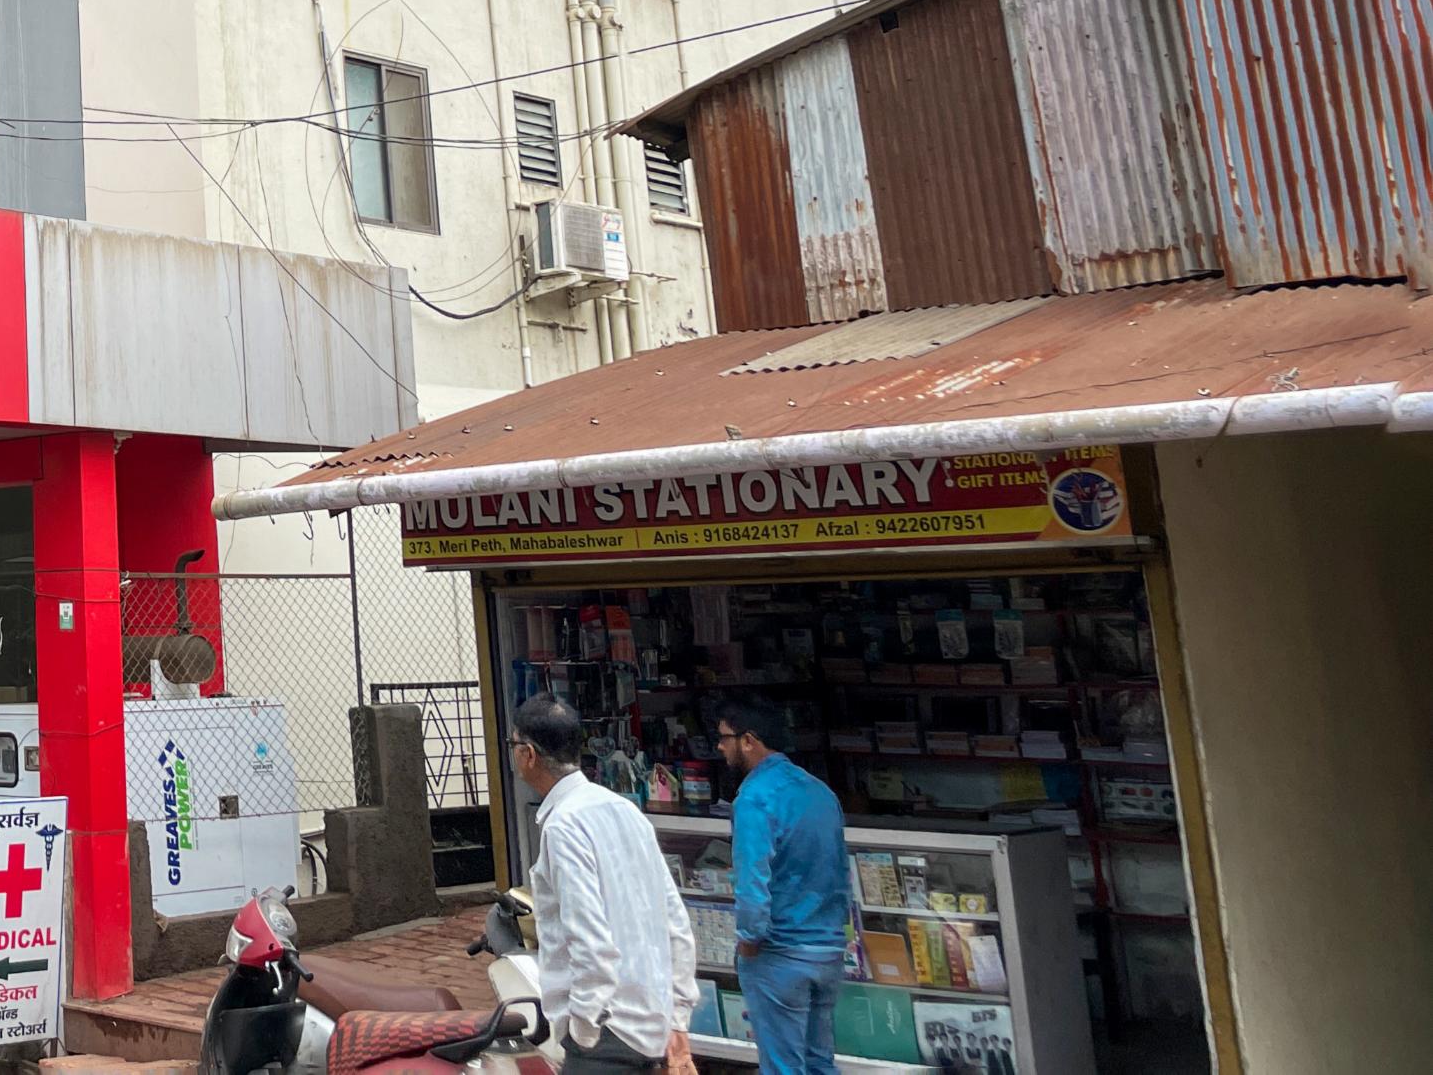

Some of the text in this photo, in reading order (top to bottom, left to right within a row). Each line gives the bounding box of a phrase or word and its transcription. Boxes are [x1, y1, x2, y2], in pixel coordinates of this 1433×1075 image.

[1065, 445, 1115, 461] ITEMS
[957, 470, 1048, 489] GIFT ITEMS
[406, 458, 942, 530] MULANI STATIONARY
[653, 528, 689, 546] Anis
[703, 523, 799, 544] 9168424137
[816, 521, 860, 537] Afzal
[876, 513, 986, 535] 9422607951
[409, 532, 624, 556] 373, Meri Peth, Mahabaleshwar
[174, 759, 193, 851] POWER
[162, 778, 181, 886] GREAVES
